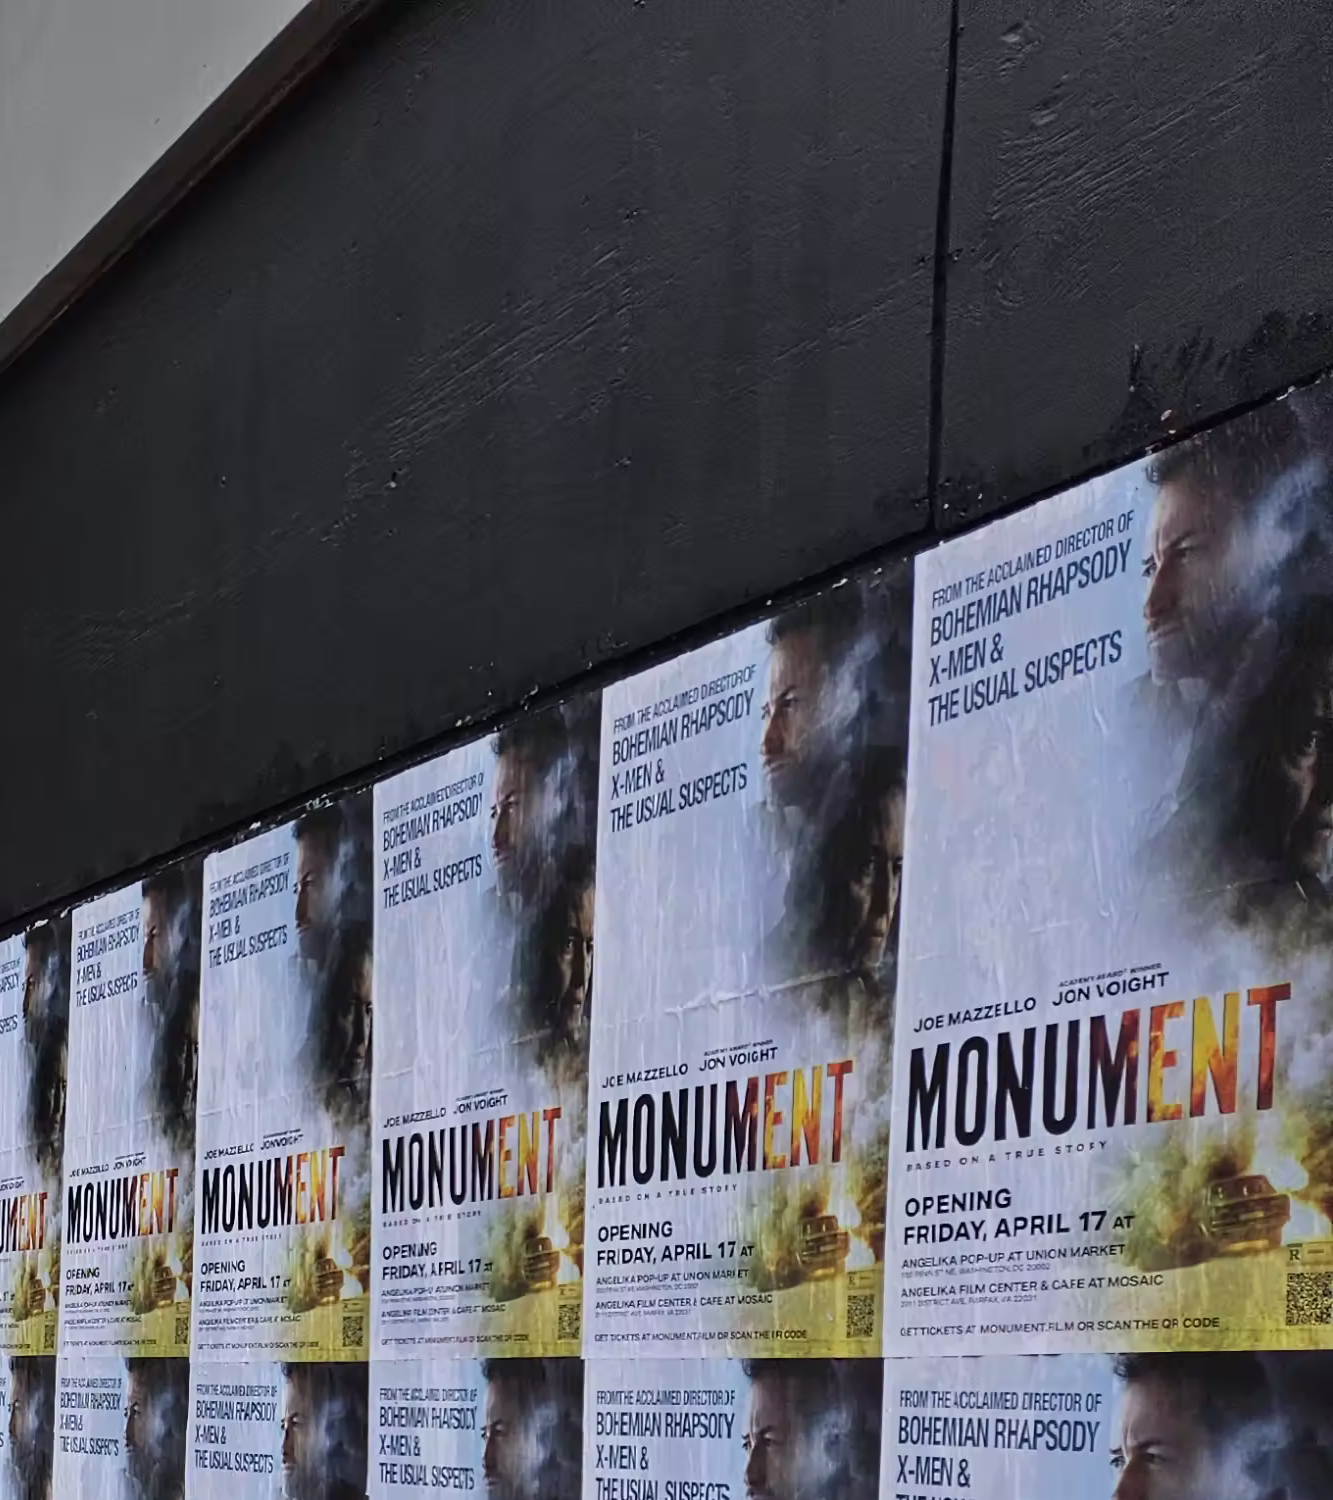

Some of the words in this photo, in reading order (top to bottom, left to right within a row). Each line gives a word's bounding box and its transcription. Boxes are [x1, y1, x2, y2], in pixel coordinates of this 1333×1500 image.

[933, 580, 962, 608] FROM
[965, 571, 985, 595] THE
[988, 543, 1052, 586] ACCLAIMED
[1055, 518, 1114, 558] DIRECTOR
[1117, 510, 1134, 533] OF
[931, 582, 1022, 646] BOHEMIAN
[1027, 539, 1132, 609] RHAPSODY
[929, 639, 985, 687] X-MEN
[990, 632, 1004, 667] &
[929, 688, 958, 725] THE
[964, 667, 1018, 713] USUAL
[1024, 630, 1122, 692] SUSPECTS
[613, 717, 677, 766] BOHEMIAN
[681, 688, 753, 742] RHAPSODY
[611, 763, 651, 800] X-MEN
[656, 759, 664, 785] &
[611, 801, 632, 832] THE
[636, 787, 675, 824] USUAL
[679, 763, 747, 810] SUSPECTS
[1053, 985, 1090, 1006] JON
[1095, 971, 1169, 999] VOIGHT
[914, 1014, 944, 1033] JOE
[948, 997, 1036, 1026] MAZZELLO
[602, 1073, 624, 1088] JOE
[626, 1063, 688, 1085] MAZZELLO
[700, 1056, 725, 1072] JON
[729, 1047, 777, 1066] VOIGHT
[906, 983, 1291, 1153] MONUMENT
[598, 1060, 853, 1188] MONUMENT
[383, 1108, 561, 1214] MONUMENT
[67, 1169, 178, 1245] MONUMENT
[201, 1146, 344, 1234] MONUMENT
[905, 1188, 1012, 1216] OPENING
[598, 1221, 672, 1242] OPENING
[904, 1221, 988, 1245] FRIDAY,
[995, 1215, 1070, 1238] APRIL
[1079, 1211, 1105, 1232] 17
[1113, 1216, 1135, 1229] AT
[597, 1246, 656, 1266] FRIDAY,
[661, 1243, 712, 1262] APRIL
[717, 1241, 736, 1258] 17
[740, 1246, 754, 1257] AT
[902, 1255, 957, 1269] ANGELIKA
[960, 1252, 1004, 1266] POP-UP
[1008, 1251, 1023, 1263] AT
[1026, 1248, 1067, 1262] UNION
[1071, 1244, 1125, 1259] MARKET
[901, 1284, 956, 1298] ANGELIKA
[959, 1283, 985, 1295] FILM
[989, 1280, 1037, 1294] CENTER
[1053, 1278, 1085, 1291] CAFE
[1089, 1277, 1105, 1290] AT
[1108, 1274, 1163, 1289] MOSAIC
[900, 1391, 928, 1408] FROM
[931, 1391, 951, 1408] THE
[954, 1392, 1018, 1410] ACCLAIMED
[1022, 1392, 1082, 1411] DIRECTOR
[1086, 1393, 1101, 1412] OF
[596, 1412, 661, 1437] BOHEMIAN
[899, 1416, 988, 1448] BOHEMIAN
[994, 1418, 1099, 1452] RHAPSODY
[640, 1446, 648, 1470] &
[897, 1456, 953, 1486] X-MEN
[957, 1460, 971, 1488] &
